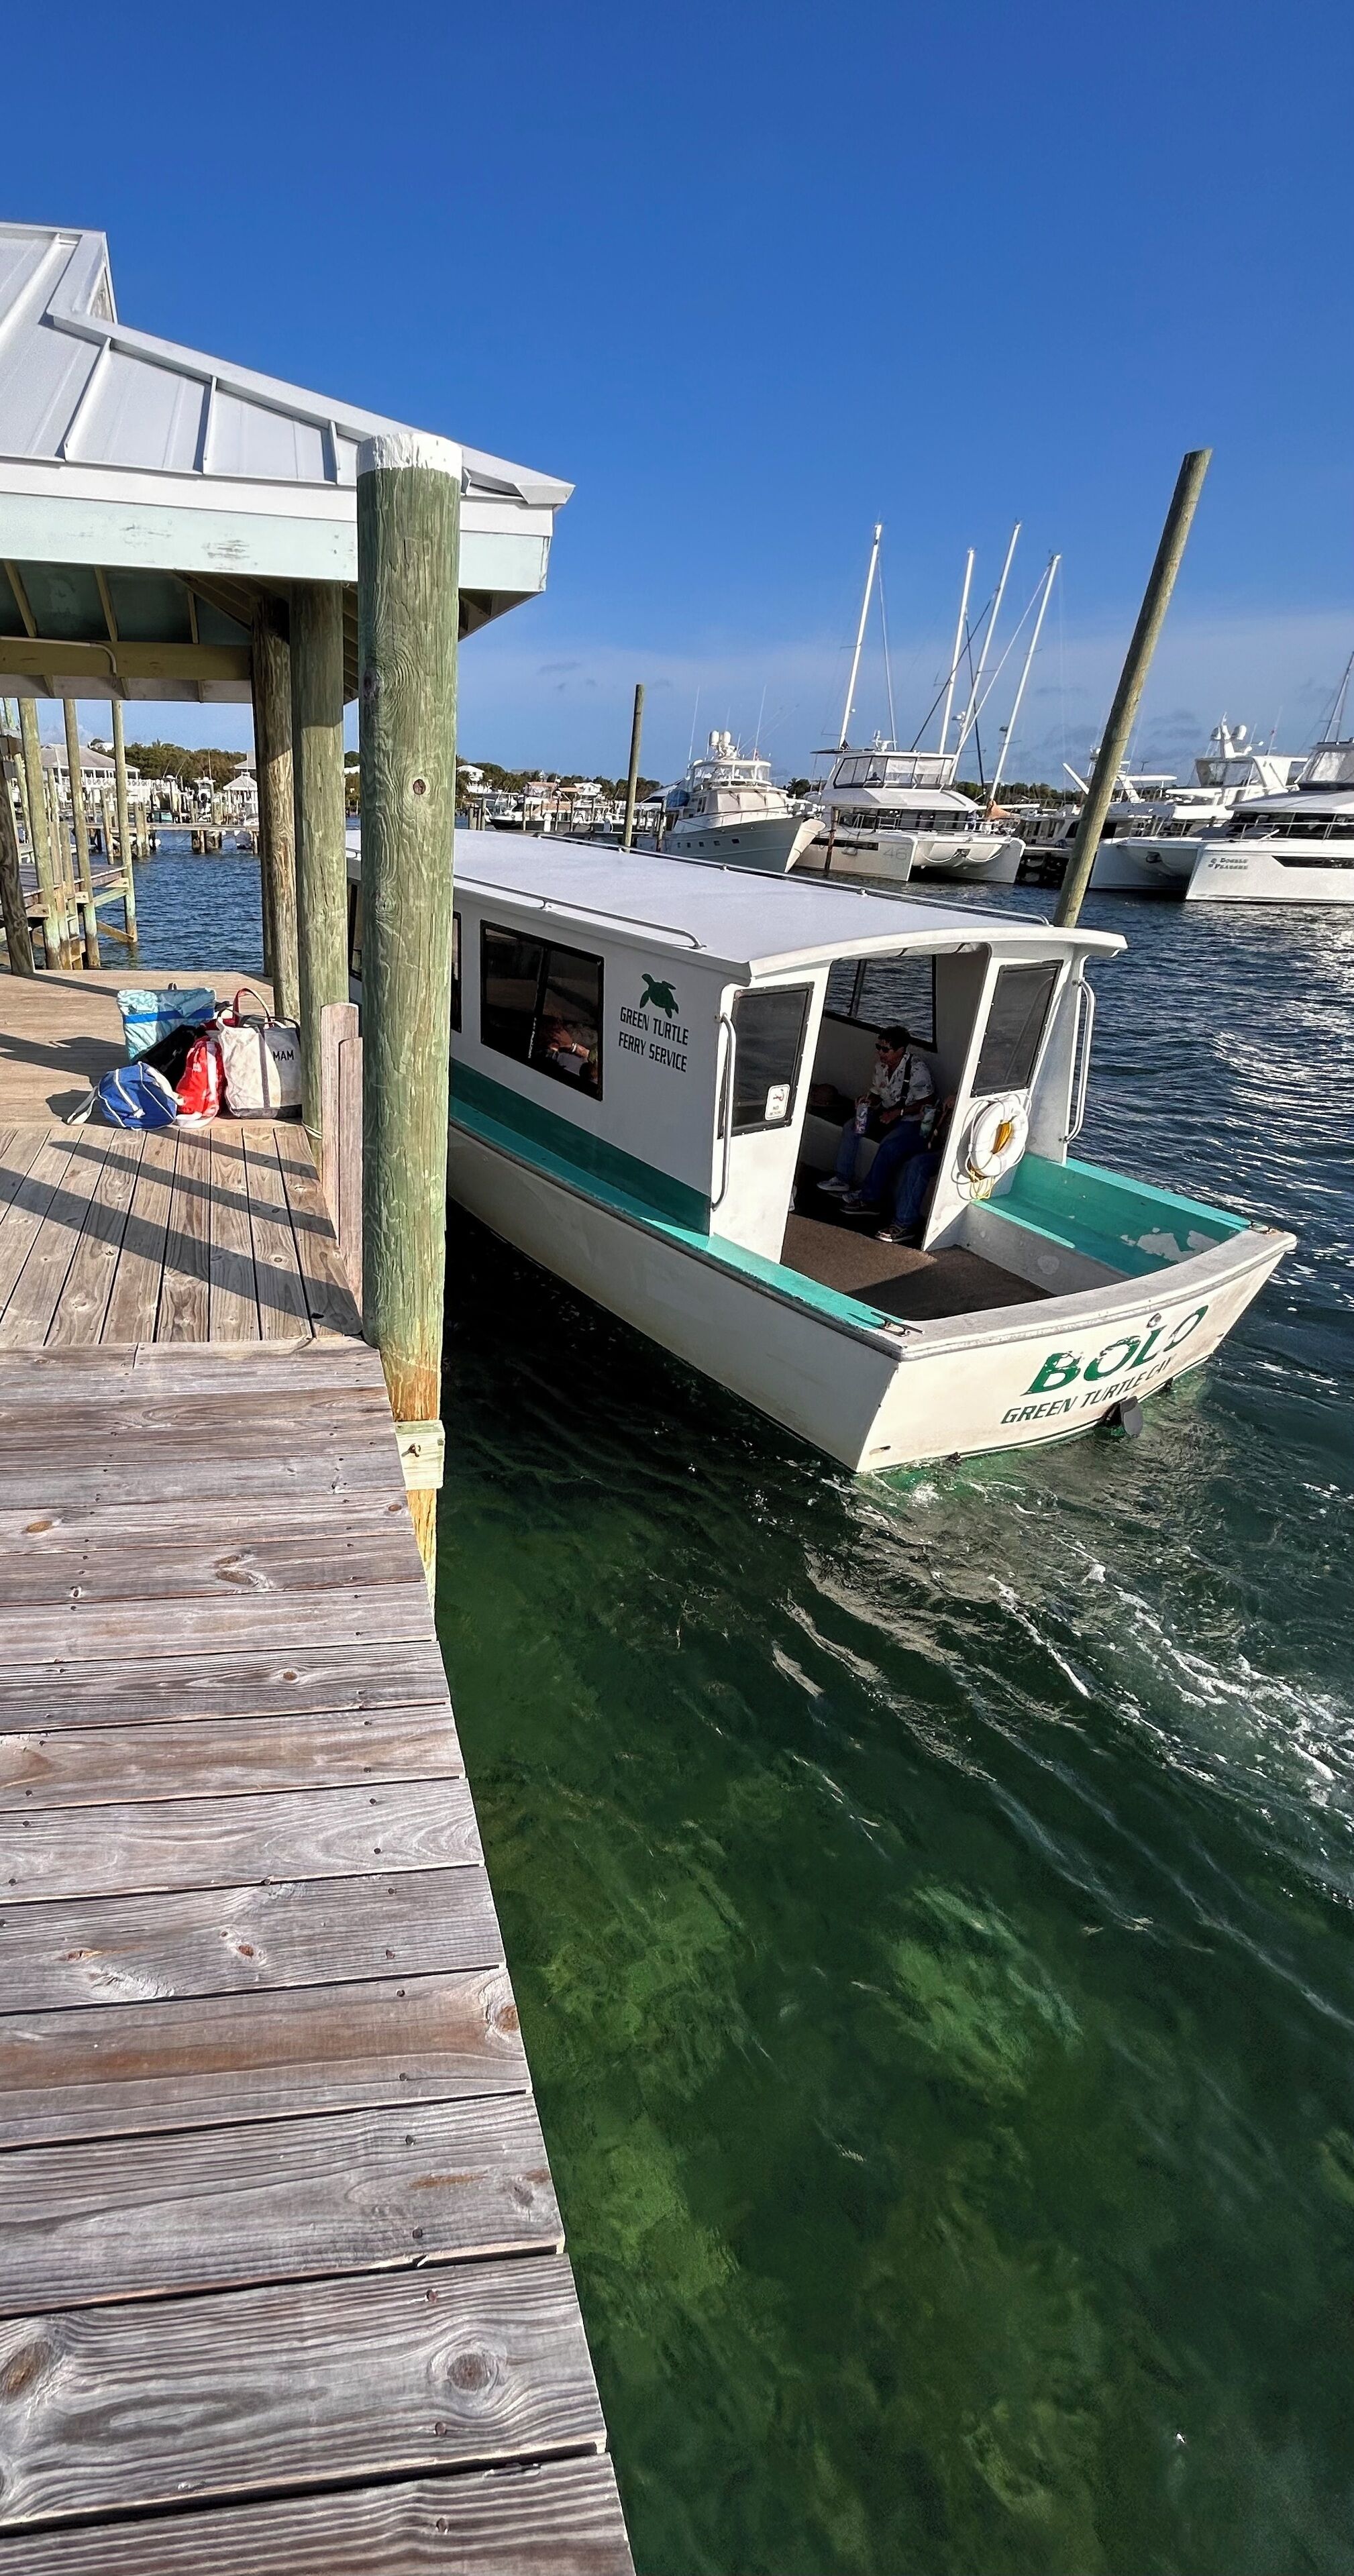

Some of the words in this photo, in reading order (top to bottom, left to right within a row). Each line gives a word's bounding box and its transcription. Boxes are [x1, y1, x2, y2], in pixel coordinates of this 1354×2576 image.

[883, 847, 907, 860] 46
[620, 1006, 649, 1031] GREEN
[653, 1017, 689, 1045] TURTLE
[272, 1050, 295, 1062] MAM
[618, 1031, 646, 1056] FERRY
[649, 1042, 687, 1073] SERVICE
[1000, 1397, 1077, 1424] GREEN
[1080, 1371, 1148, 1409] TURTLE
